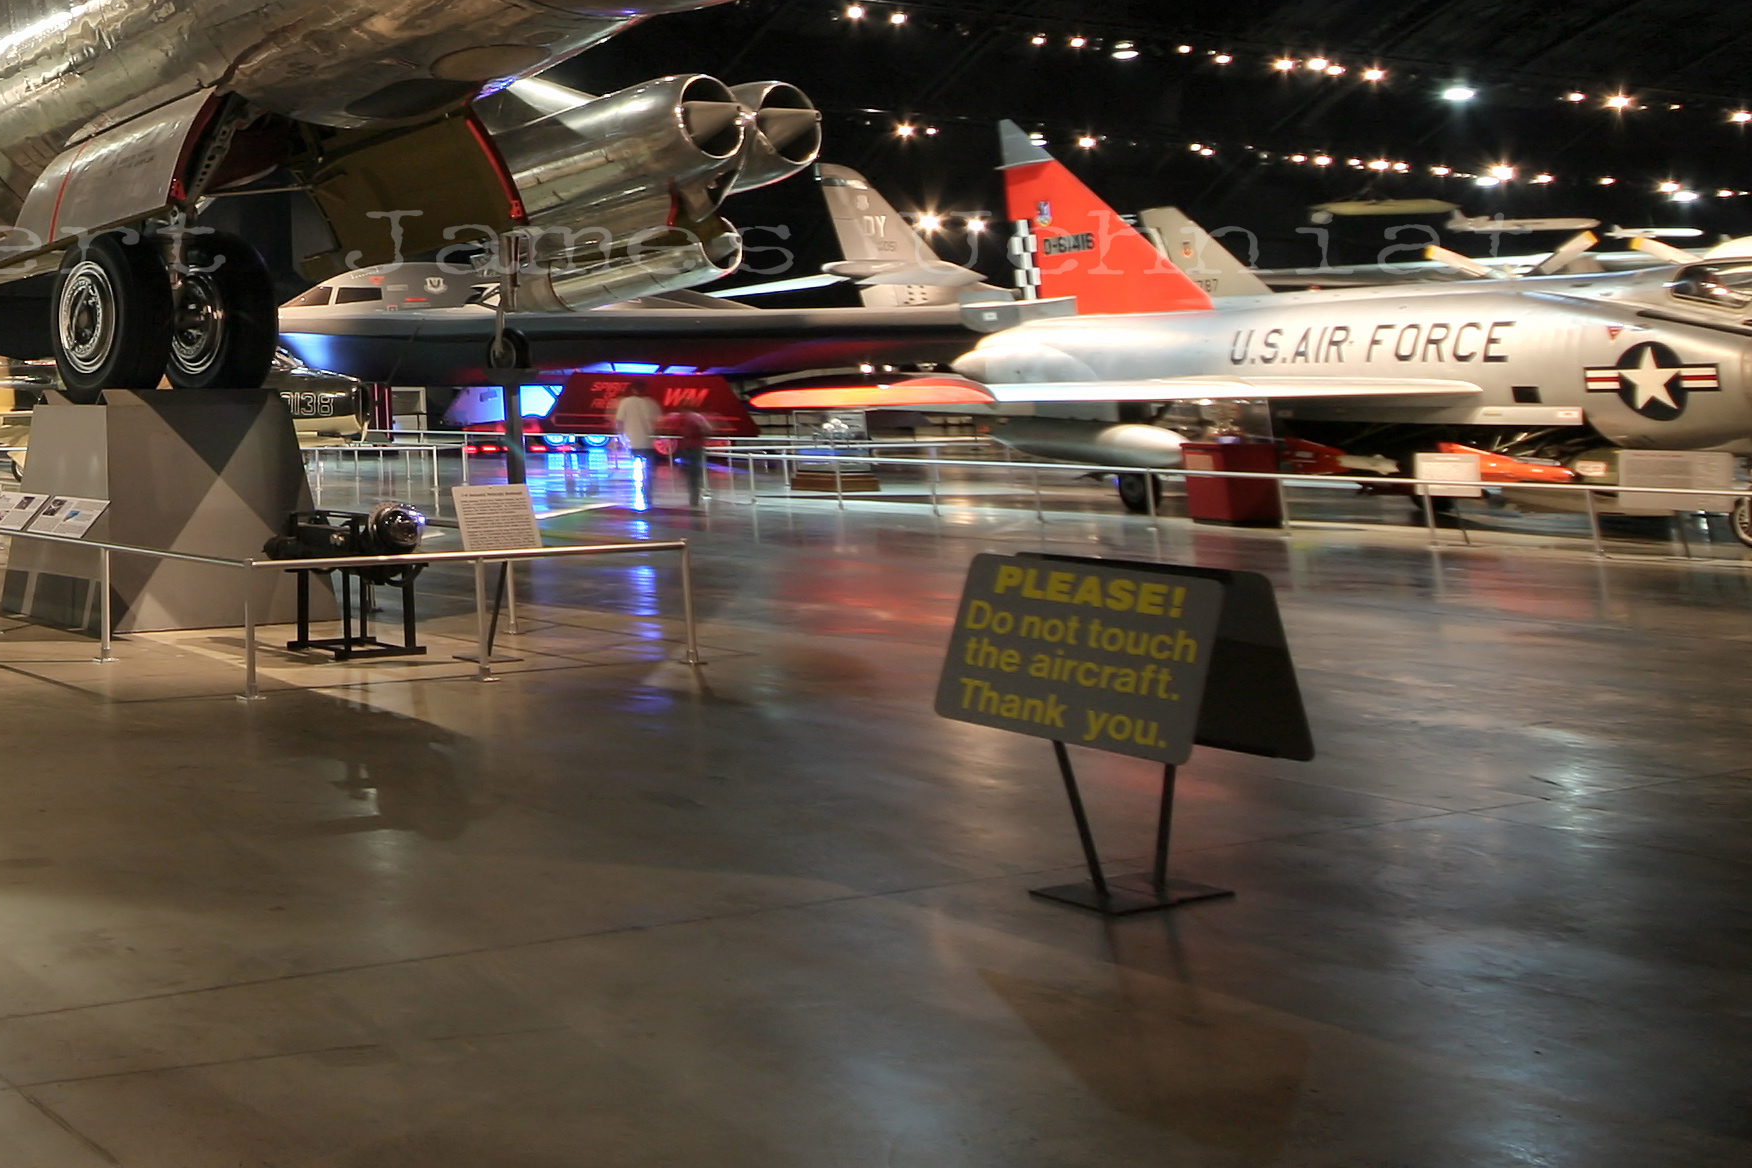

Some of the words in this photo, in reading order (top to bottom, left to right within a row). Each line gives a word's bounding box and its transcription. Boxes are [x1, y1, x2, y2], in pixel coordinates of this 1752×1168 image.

[862, 215, 887, 238] DY
[1365, 320, 1517, 364] FORCE
[994, 564, 1188, 619] PLEASE!
[965, 599, 1014, 636] Do
[1019, 614, 1082, 646] not
[1086, 618, 1199, 664] touch
[964, 636, 1023, 674] the
[1028, 649, 1181, 702] aircraft.
[959, 677, 1069, 730] Thank
[1083, 709, 1169, 750] you.
